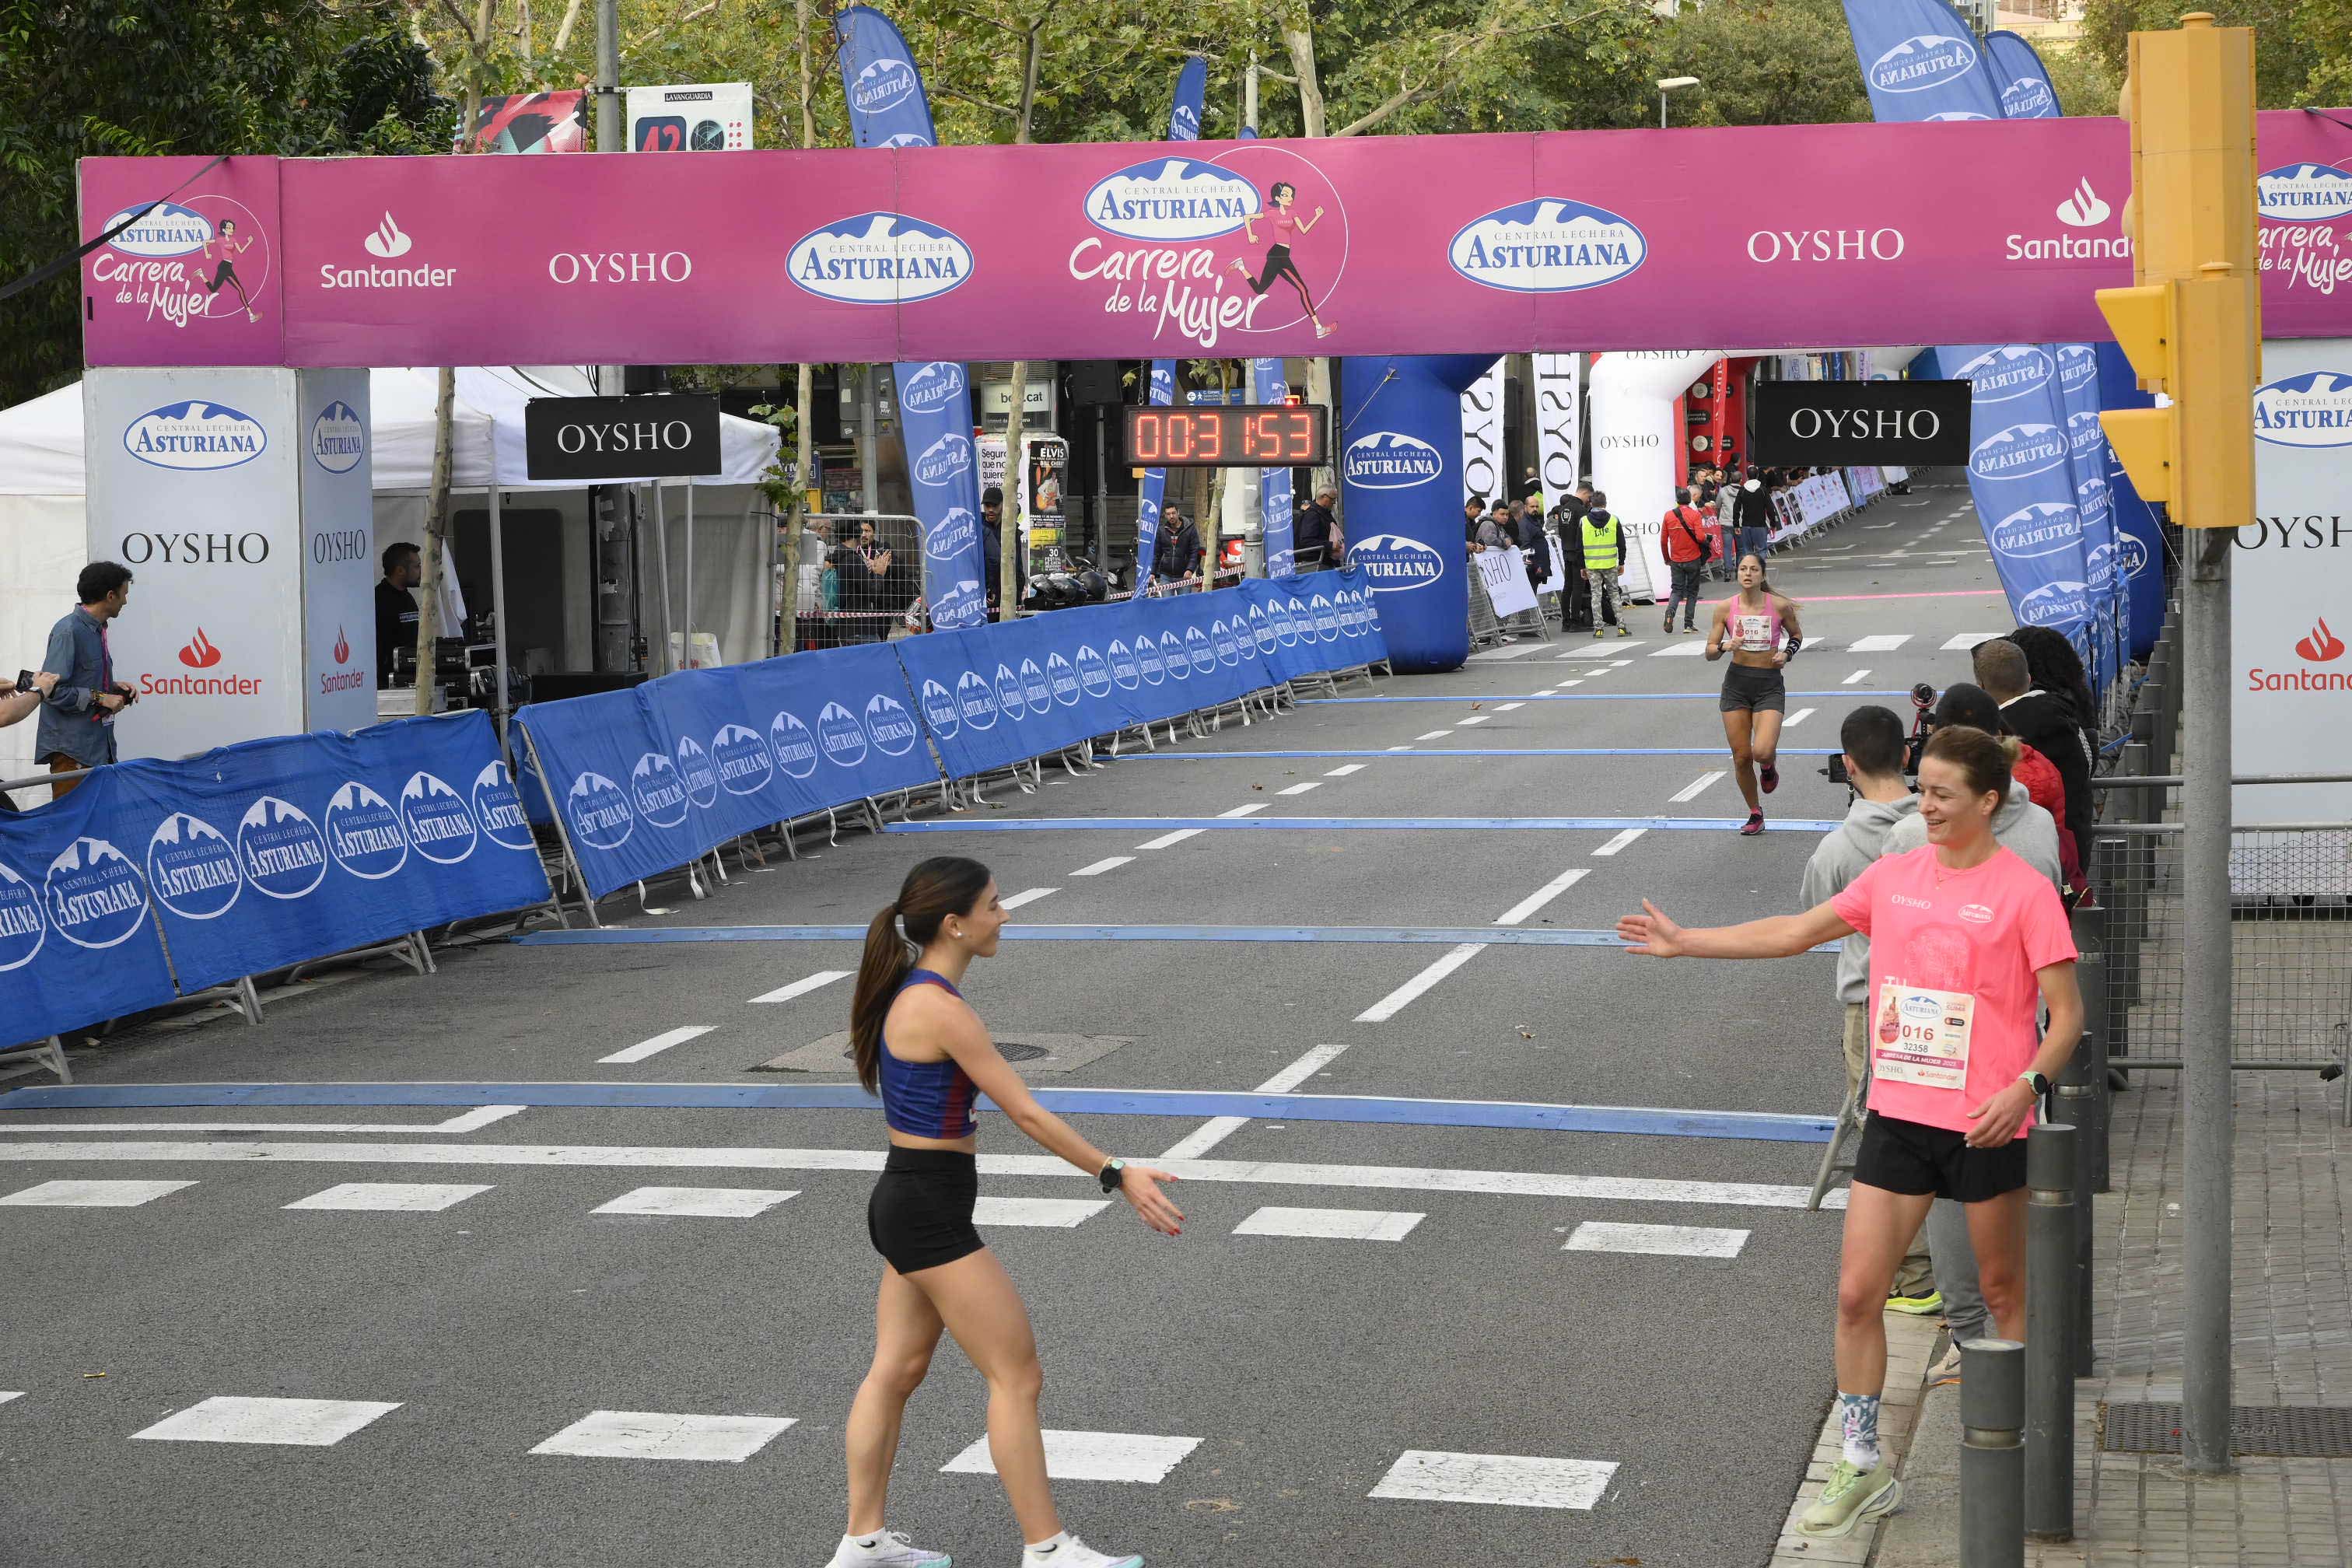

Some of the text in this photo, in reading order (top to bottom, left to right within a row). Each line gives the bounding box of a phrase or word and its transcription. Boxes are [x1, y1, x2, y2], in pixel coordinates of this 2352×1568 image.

[1125, 184, 1243, 195] CENTRAL LECHERA
[1097, 189, 1246, 221] ASTURIANA
[112, 222, 204, 242] ASTURIANA
[1494, 229, 1626, 241] CENTRAL LECHERA
[1747, 227, 1904, 262] OYSHO
[2259, 226, 2333, 247] arrera
[829, 243, 953, 254] CENTRAL LECHERA
[1069, 237, 1214, 280] Carrera
[1464, 234, 1632, 269] ASTURIANA
[2006, 233, 2134, 260] Santand
[93, 253, 185, 283] Carrera
[548, 251, 692, 284] OYSHO
[800, 247, 959, 280] ASTURIANA
[2278, 250, 2291, 270] la
[2287, 244, 2352, 295] Muje
[320, 264, 457, 289] Santander
[116, 283, 219, 327] de la Mujer
[1105, 279, 1269, 348] de la Mujer
[1790, 408, 1940, 439] OYSHO
[135, 426, 257, 453] ASTURIANA
[316, 427, 361, 456] ASTURIANA
[558, 420, 691, 453] OYSHO
[1601, 434, 1659, 450] OYSHO
[1041, 448, 1063, 457] ELVIS
[982, 461, 995, 470] que
[1347, 455, 1434, 477] ASTURIANA
[1594, 527, 1609, 537] Life
[1624, 522, 1661, 536] SHO
[121, 533, 269, 564] OYSHO
[314, 529, 366, 564] OYSHO
[139, 673, 262, 695] Santander
[320, 670, 365, 695] Santander
[2249, 668, 2352, 692] Santan
[778, 740, 814, 765] ASTURIANA
[823, 729, 865, 753] ASTURIANA
[716, 751, 770, 781] ASTURIANA
[340, 815, 366, 828] CENTRAL
[408, 809, 473, 844] ASTURIANA
[254, 825, 312, 846] CENTRAL LECHERA
[333, 821, 405, 859] ASTURIANA
[165, 845, 226, 863] CENTRAL LECHERA
[245, 839, 324, 879] ASTURIANA
[157, 857, 238, 898] ASTURIANA
[1892, 894, 1930, 909] OYSHO
[1905, 1002, 1938, 1013] ASTURIANA
[1902, 1025, 1934, 1041] 016
[1904, 1042, 1928, 1053] 32358
